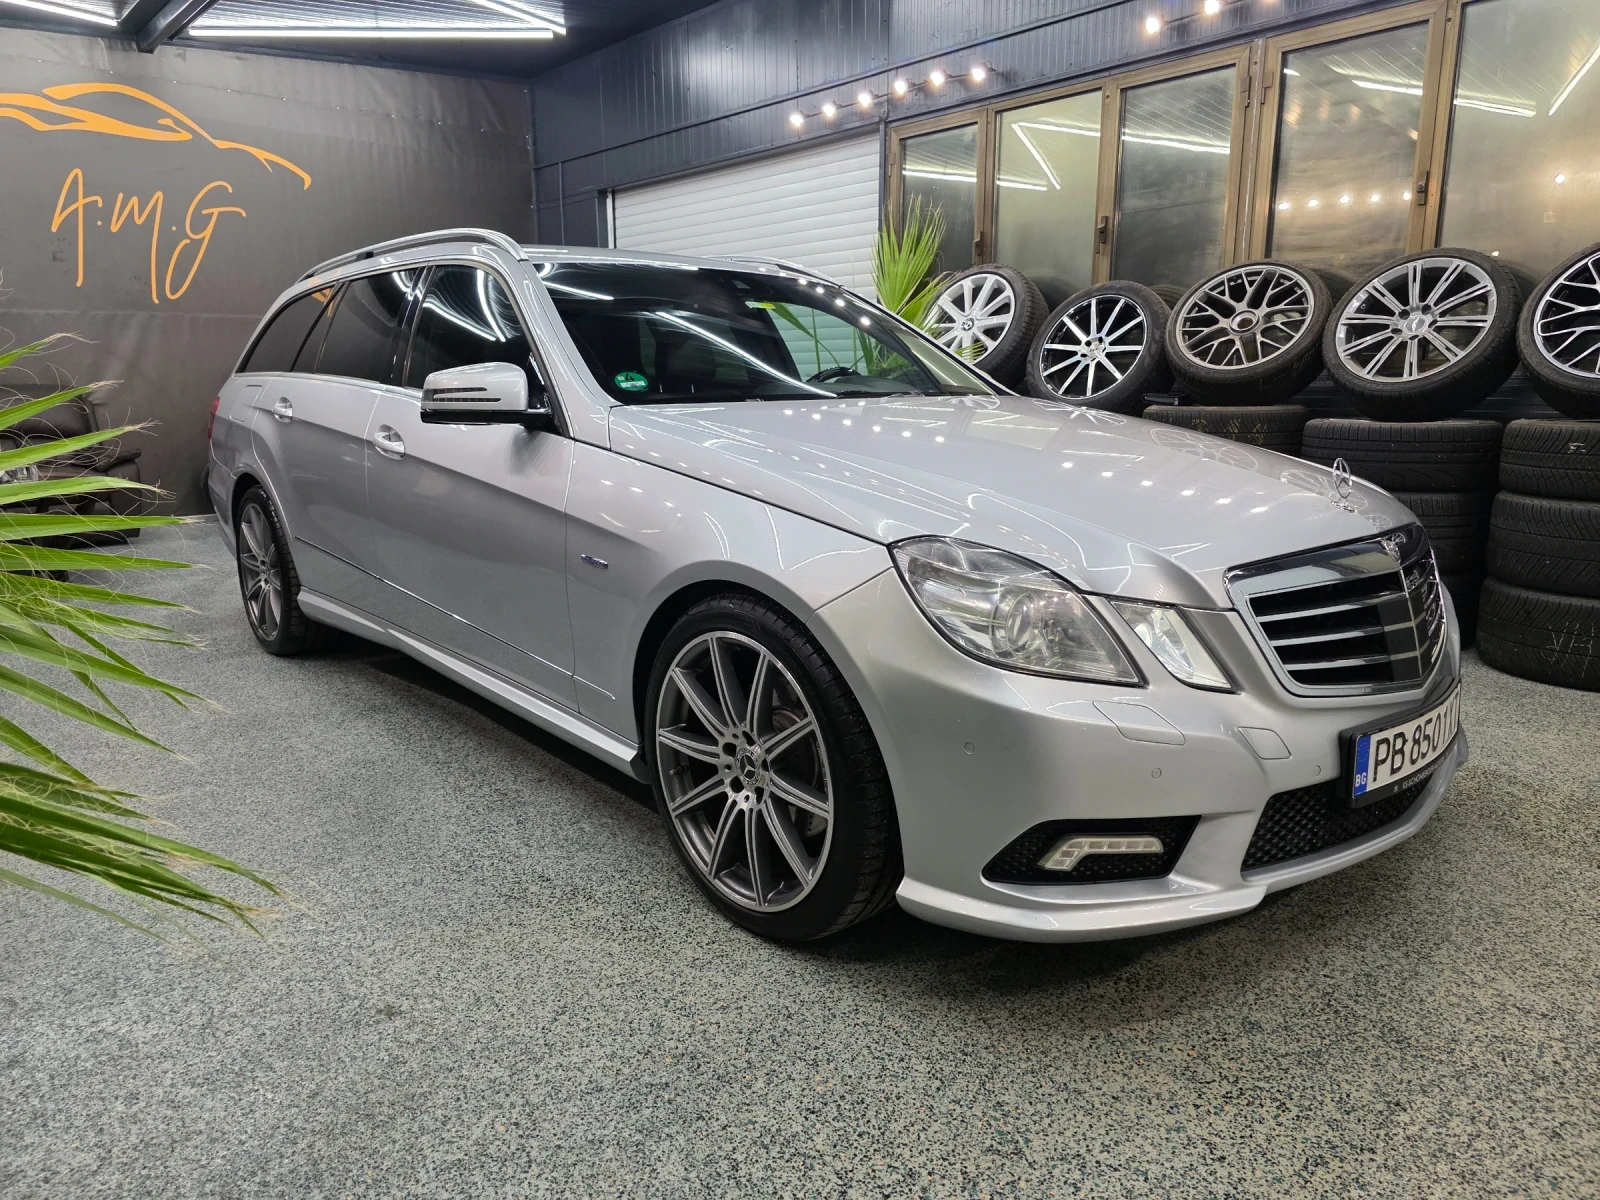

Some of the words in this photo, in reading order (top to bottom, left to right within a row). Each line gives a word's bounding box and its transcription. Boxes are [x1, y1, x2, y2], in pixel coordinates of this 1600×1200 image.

[1373, 732, 1407, 782] PB
[1410, 705, 1448, 765] 8501
[1355, 772, 1367, 787] BG
